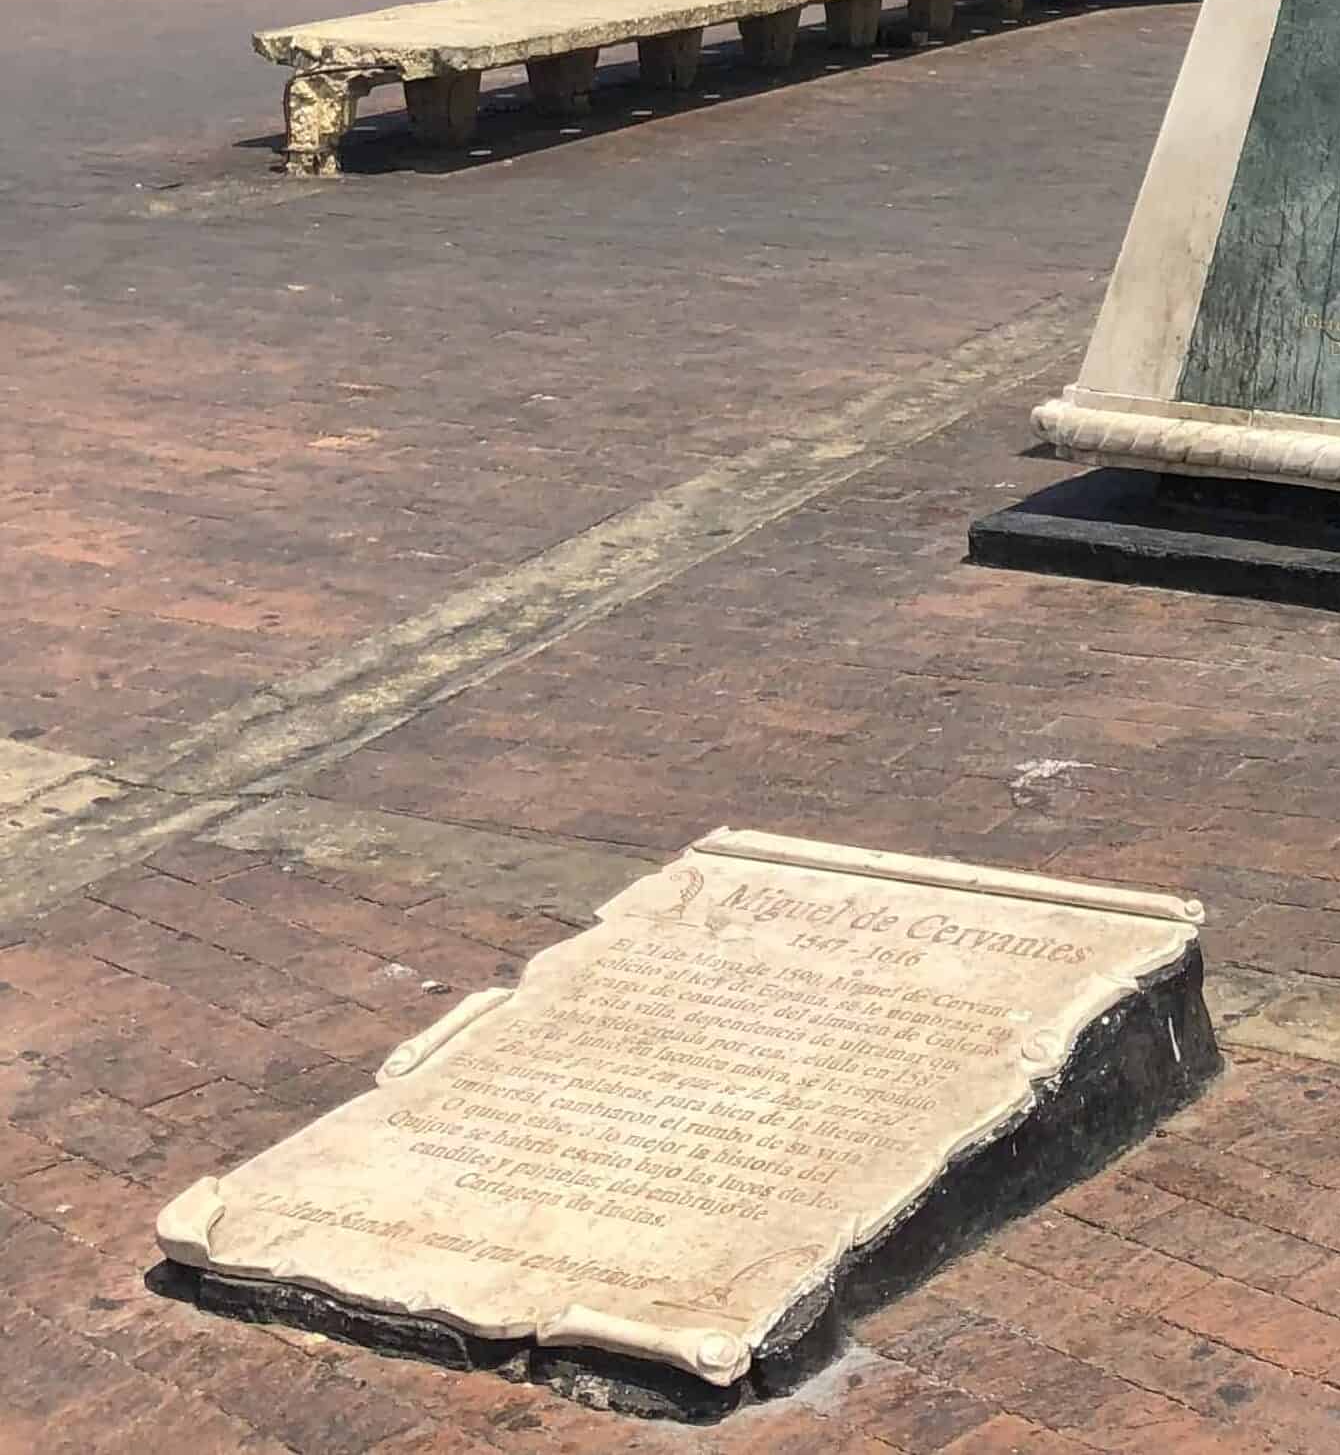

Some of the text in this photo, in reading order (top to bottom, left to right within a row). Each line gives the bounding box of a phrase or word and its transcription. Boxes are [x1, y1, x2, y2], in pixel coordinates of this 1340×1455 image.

[718, 884, 1091, 964] Miguel de Cervantes
[861, 945, 926, 967] 1616
[711, 1148, 793, 1176] historia
